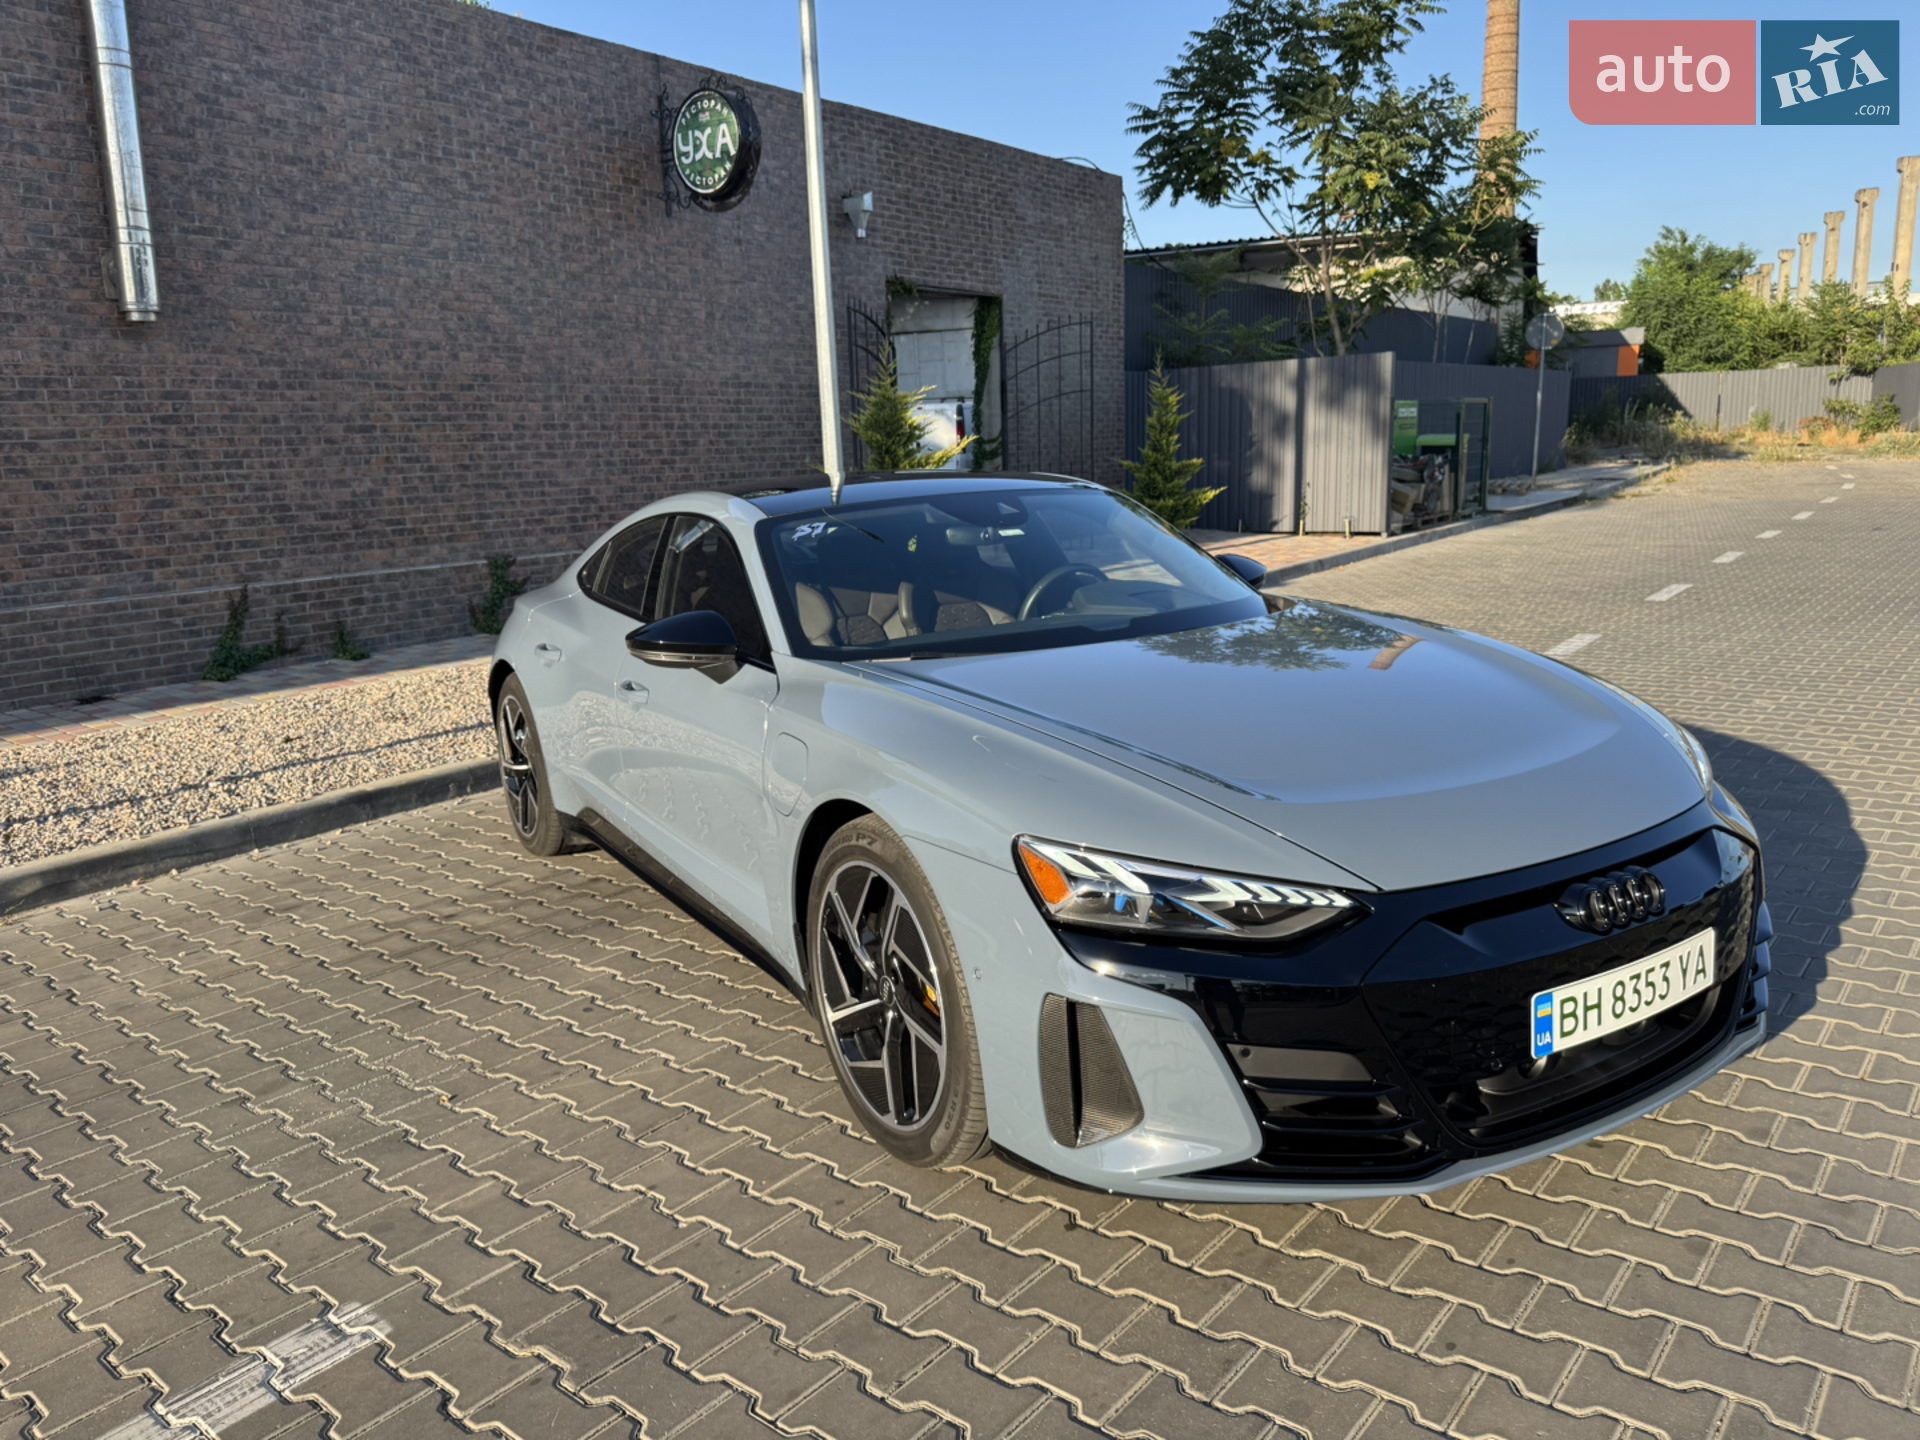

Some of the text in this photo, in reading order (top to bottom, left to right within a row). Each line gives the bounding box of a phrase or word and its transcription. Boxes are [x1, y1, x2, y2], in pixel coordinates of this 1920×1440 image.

[1559, 944, 1707, 1039] BH 8353 YA
[1536, 1031, 1552, 1046] UA
